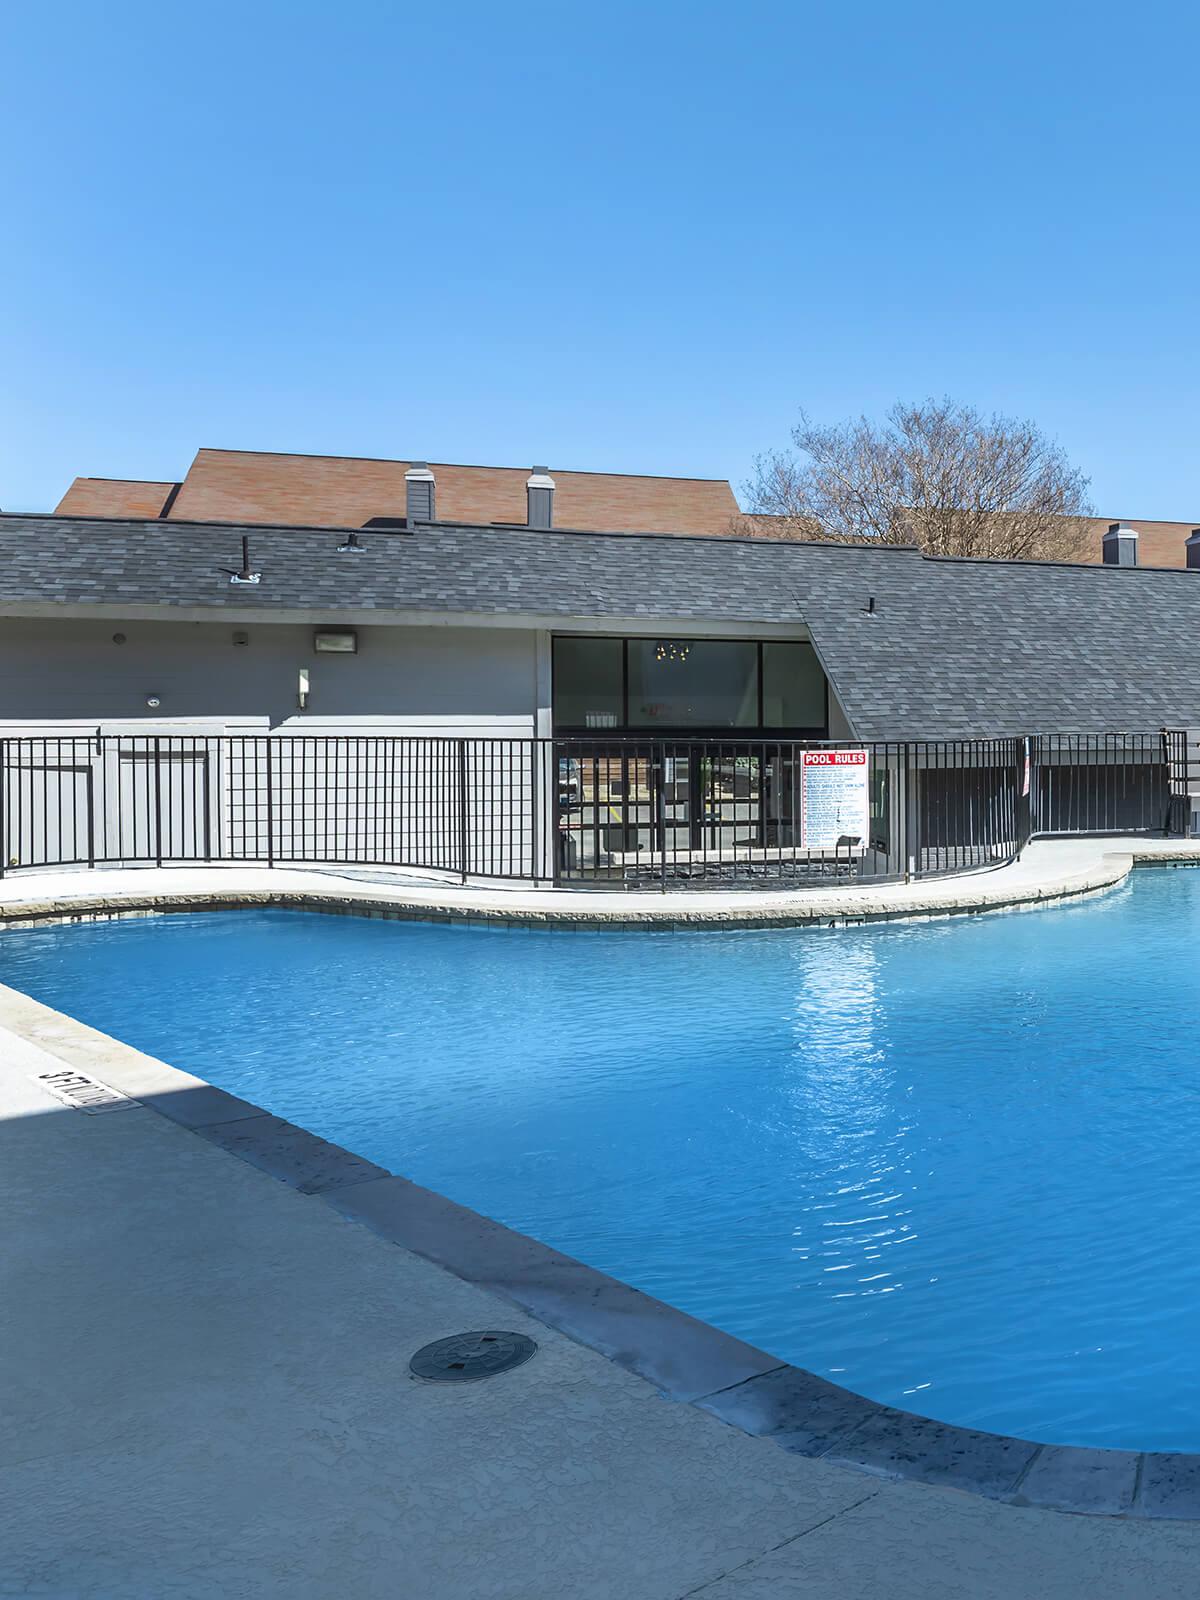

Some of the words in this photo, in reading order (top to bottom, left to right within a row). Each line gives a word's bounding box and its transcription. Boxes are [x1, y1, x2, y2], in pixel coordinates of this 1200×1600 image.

[806, 755, 832, 764] POOL
[835, 754, 865, 763] RULES
[38, 1071, 75, 1079] 3
[47, 1076, 92, 1089] FT
